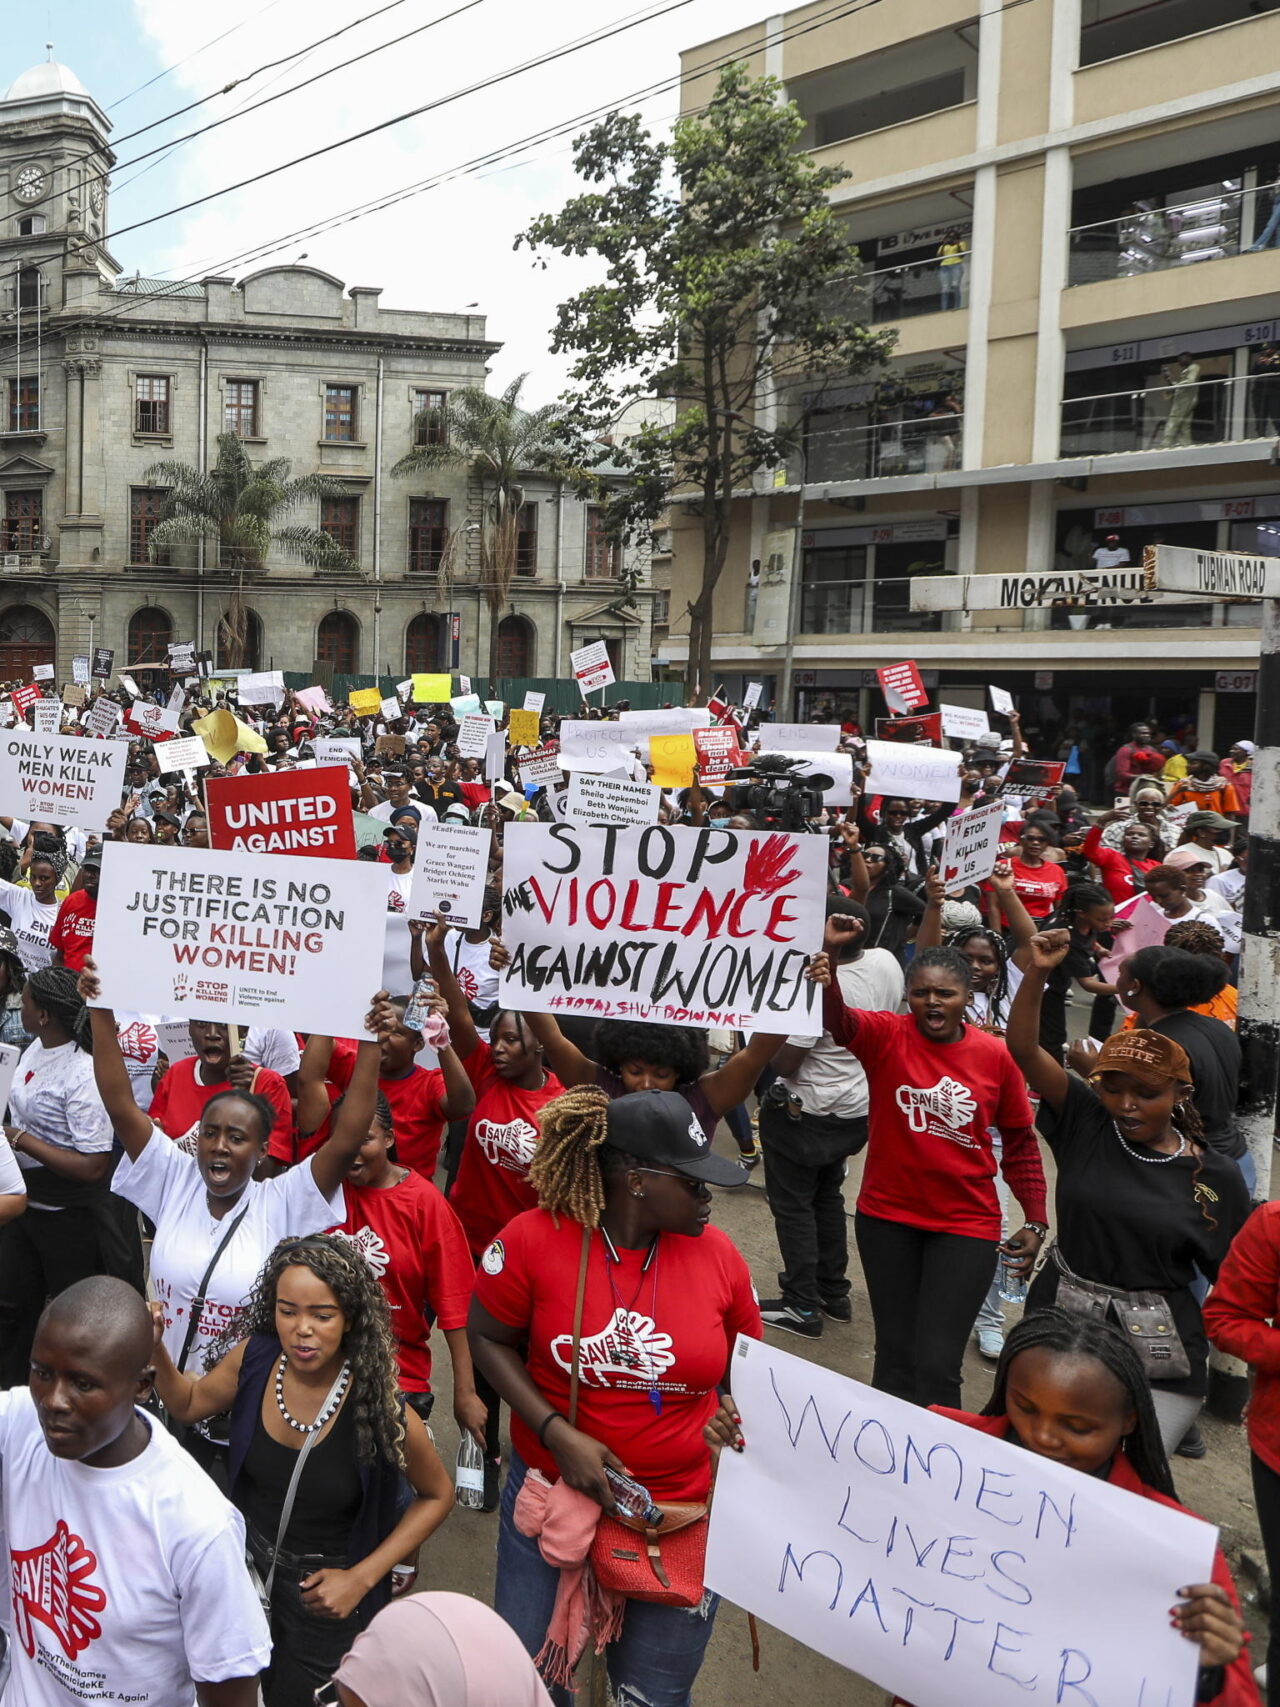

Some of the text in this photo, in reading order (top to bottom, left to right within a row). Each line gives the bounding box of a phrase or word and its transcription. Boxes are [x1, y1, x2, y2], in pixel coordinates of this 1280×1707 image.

[1197, 554, 1265, 594] TUBMAN ROAD
[1219, 672, 1251, 689] G-07
[568, 722, 625, 741] PROTECT
[698, 730, 719, 738] Being
[8, 742, 113, 767] ONLY WEAK
[587, 746, 607, 759] US
[18, 761, 96, 783] MEN KILL
[706, 764, 733, 772] death
[881, 763, 958, 779] WOMEN
[22, 778, 94, 800] WOMEN!
[580, 777, 651, 796] SAY THEIR NAMES
[1002, 788, 1048, 796] NAMES
[580, 788, 649, 806] Sheila Jepkemboi
[225, 795, 337, 829] UNITED
[573, 808, 651, 825] Elizabeth Chepkurui
[587, 800, 639, 815] Beth Wanjiku
[952, 810, 989, 828] END FEMICIDE
[432, 826, 479, 836] #EndFemicide
[964, 821, 986, 838] STOP
[232, 825, 338, 853] AGAINST
[956, 838, 988, 858] KILLING
[449, 846, 480, 854] marching
[541, 821, 738, 883] STOP
[423, 867, 475, 880] Bridget Ochieng
[448, 862, 475, 870] Wangari
[964, 861, 975, 873] US
[152, 870, 332, 905] THERE IS NO
[427, 876, 448, 885] Starlet
[127, 892, 345, 931] JUSTIFICATION
[502, 874, 802, 943] THE VIOLENCE
[143, 917, 324, 953] FOR KILLING
[173, 943, 297, 976] WOMEN!
[196, 980, 229, 991] STOP
[505, 940, 815, 1016] AGAINST WOMEN
[195, 995, 228, 1003] WOMEN!
[238, 1000, 260, 1008] Women
[239, 994, 286, 1005] Violence against
[547, 995, 756, 1029] #TOTALSHUTDOWNKE
[911, 1081, 954, 1124] SAY NAMES
[488, 1127, 506, 1143] SAY
[578, 1339, 608, 1366] SAY
[768, 1367, 1077, 1548] WOMEN
[837, 1485, 1033, 1606] LIVES
[12, 1555, 43, 1603] SAY
[778, 1542, 1098, 1707] MATTER
[117, 1693, 149, 1702] Again!
